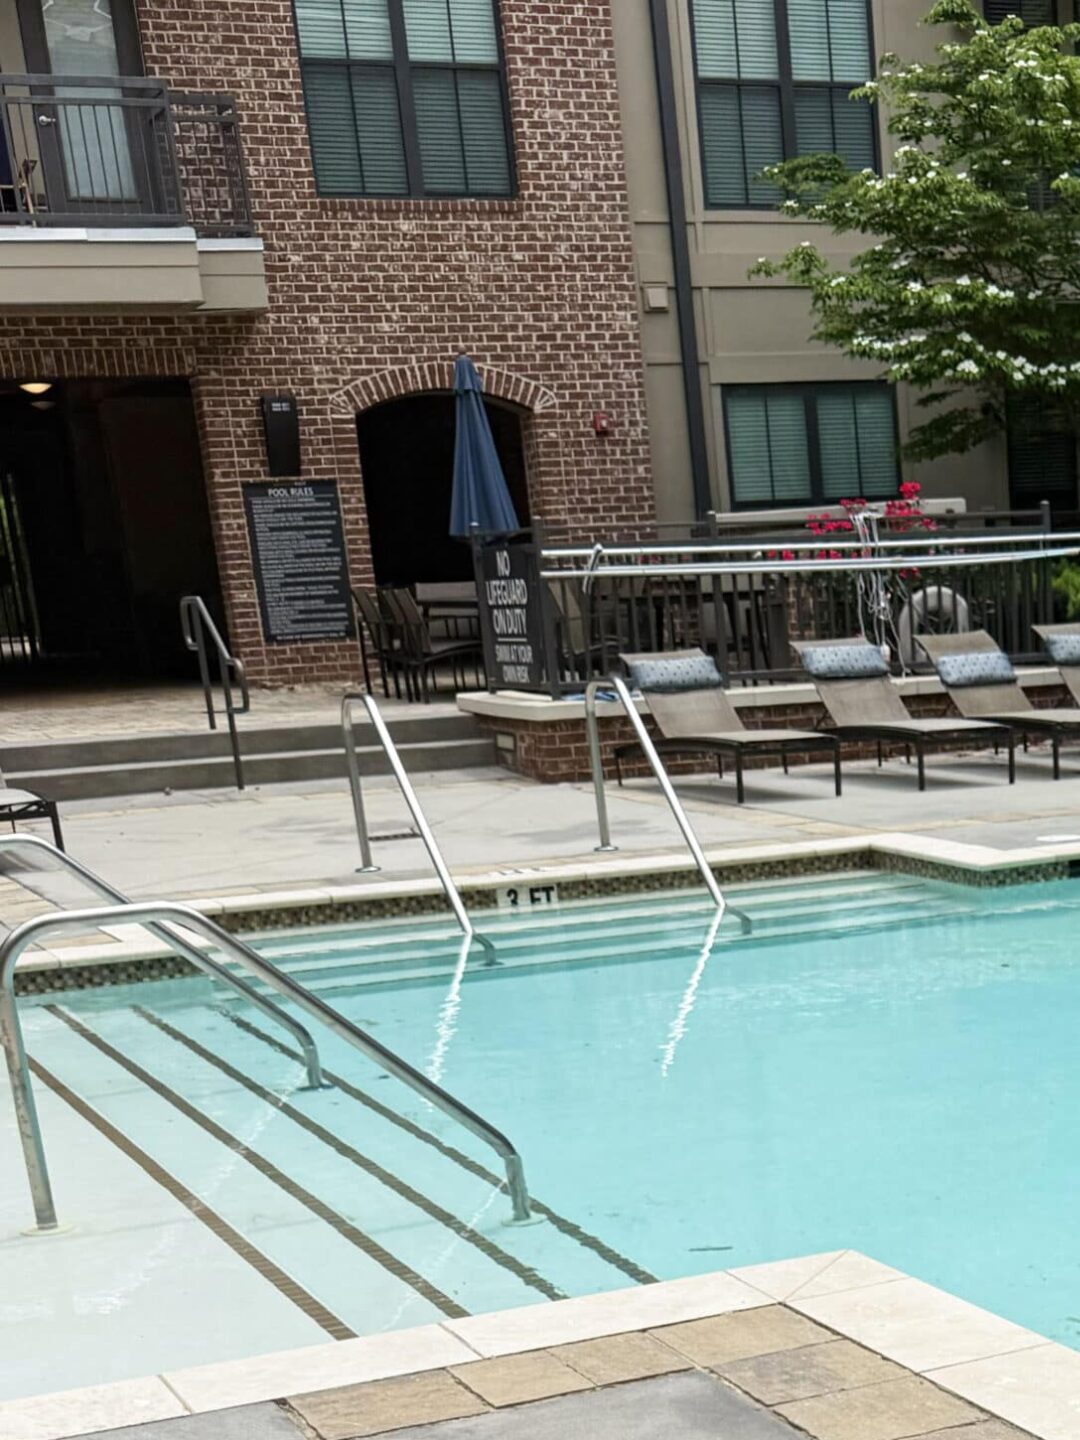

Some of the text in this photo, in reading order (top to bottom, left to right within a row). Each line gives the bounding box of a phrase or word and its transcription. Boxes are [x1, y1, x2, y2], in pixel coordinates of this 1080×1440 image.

[267, 486, 314, 497] POOL RULES
[496, 550, 511, 577] NO
[485, 578, 528, 606] LIFEGUARD
[493, 608, 527, 635] ON DUTY
[495, 644, 533, 664] SWIM AT YOUR
[503, 665, 530, 683] OWN RISK
[529, 885, 555, 905] FT
